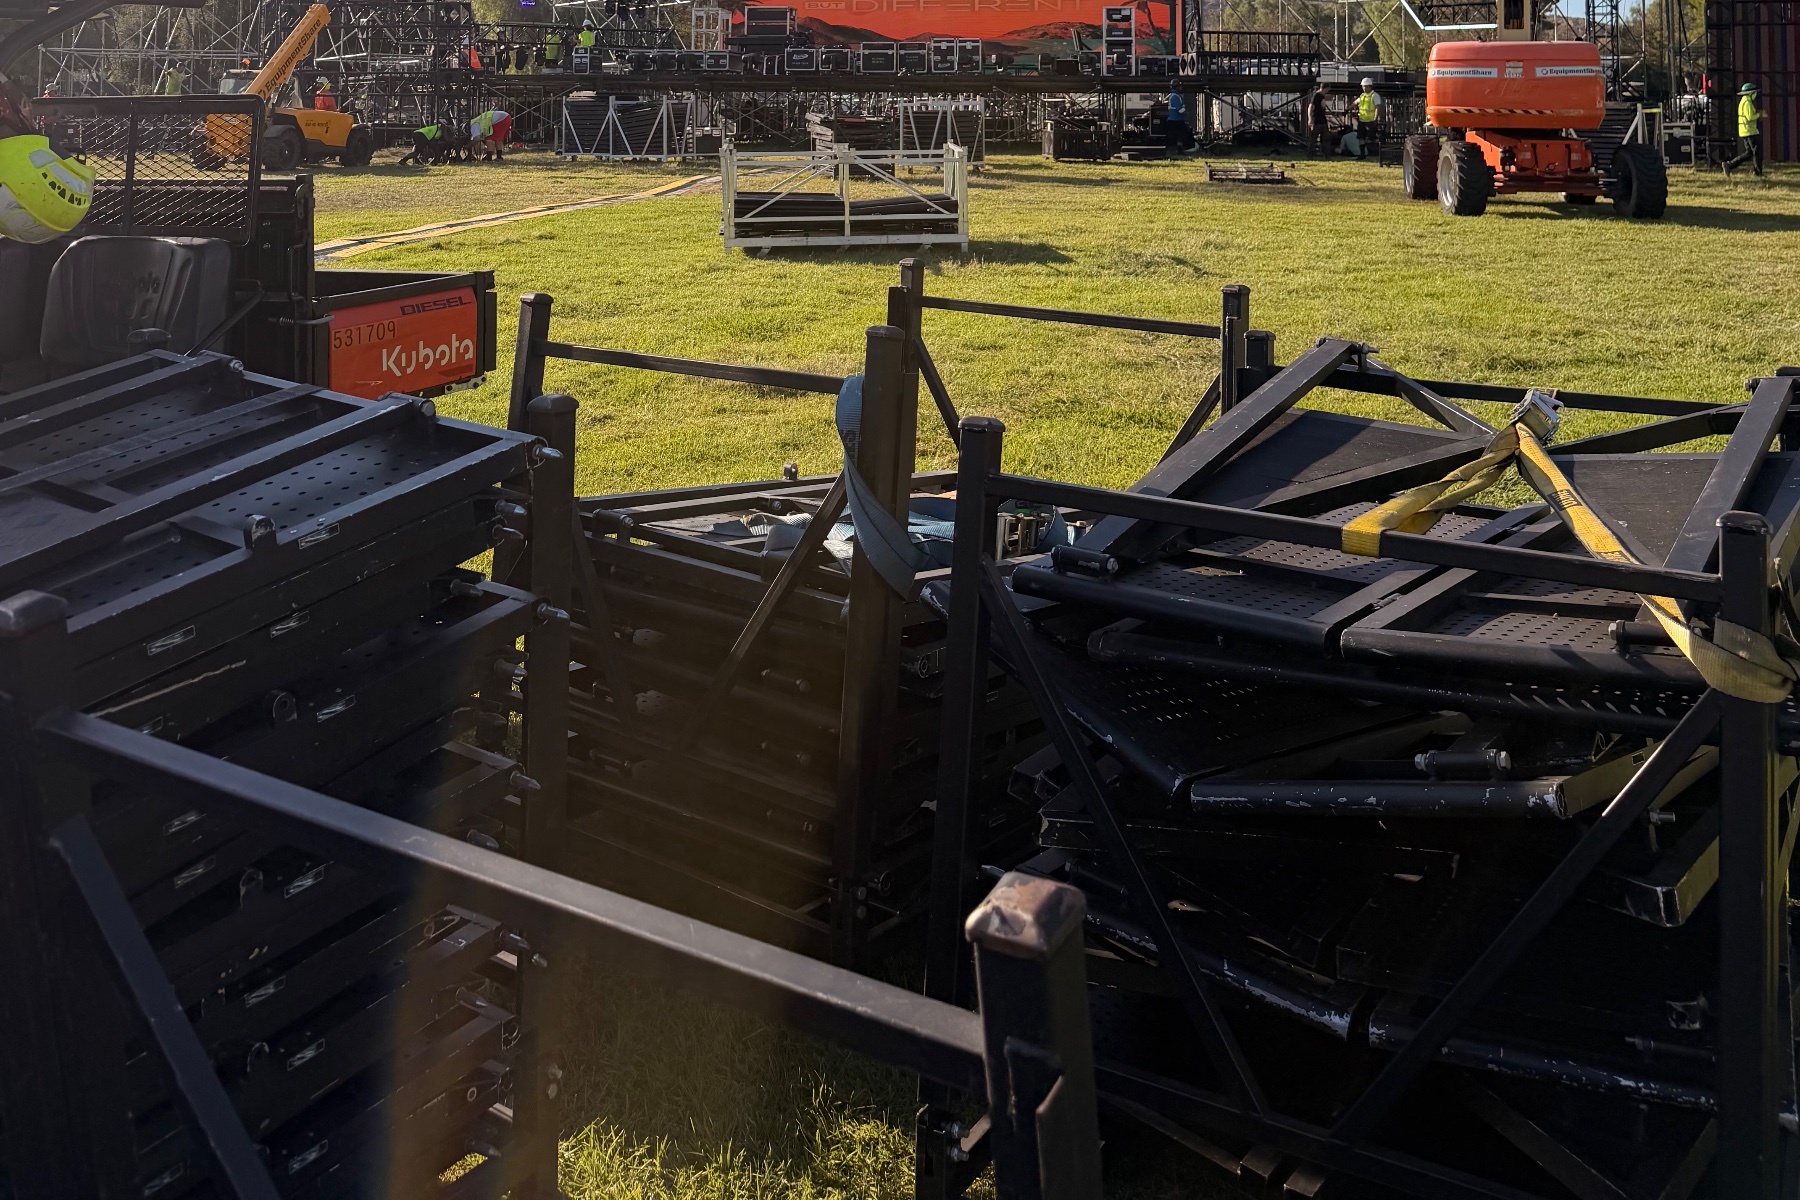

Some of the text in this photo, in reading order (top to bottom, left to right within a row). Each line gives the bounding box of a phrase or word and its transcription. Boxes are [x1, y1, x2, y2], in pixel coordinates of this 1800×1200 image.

[264, 19, 322, 93] EquipmentShare
[400, 296, 472, 316] DIESEL
[333, 320, 396, 349] 531709
[382, 333, 474, 377] Kubota
